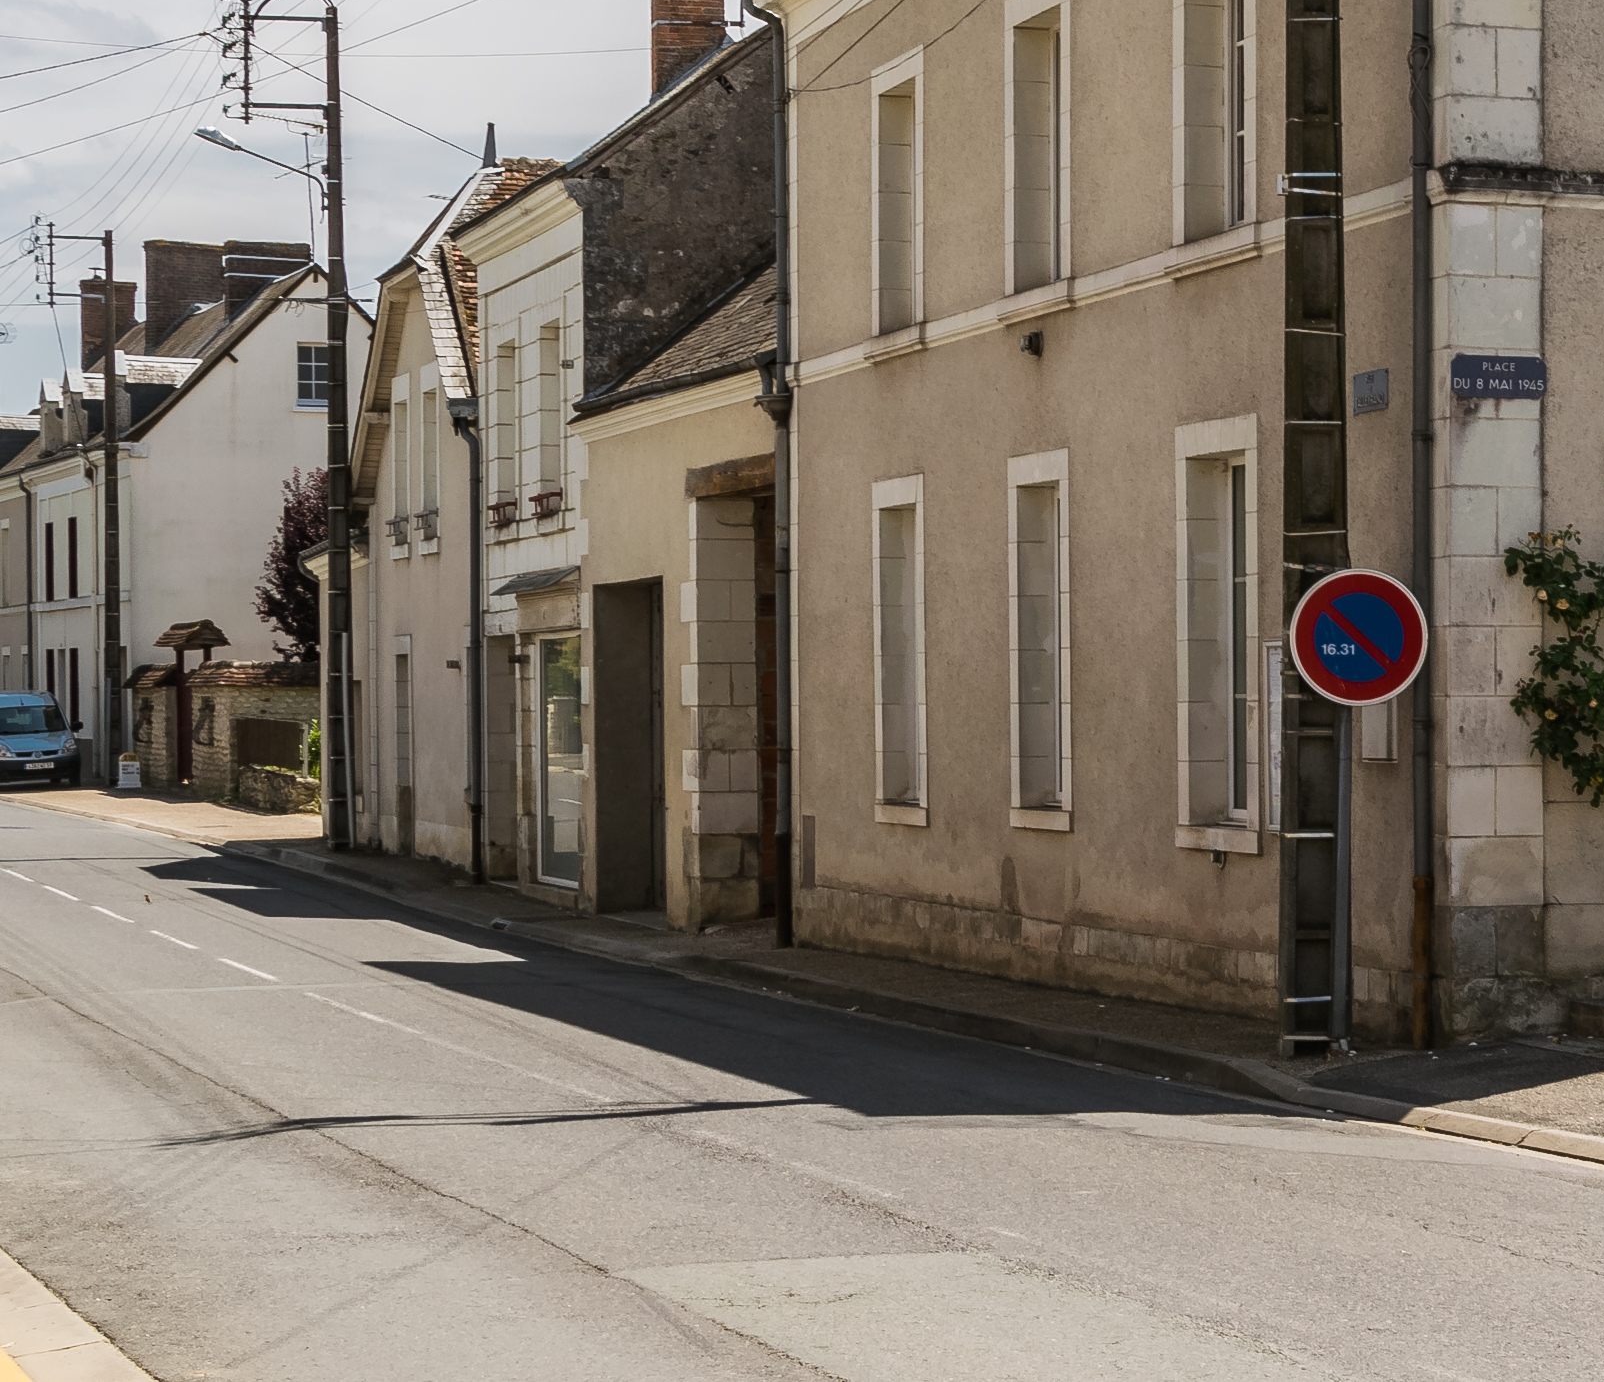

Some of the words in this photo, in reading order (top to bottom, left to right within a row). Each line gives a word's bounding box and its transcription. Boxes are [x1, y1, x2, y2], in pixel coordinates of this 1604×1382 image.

[1481, 361, 1516, 372] PLACE
[1453, 377, 1471, 390] DU
[1476, 378, 1484, 390] 8
[1488, 378, 1513, 391] MAI
[1518, 379, 1545, 391] 1945
[1321, 643, 1355, 655] 16.31
